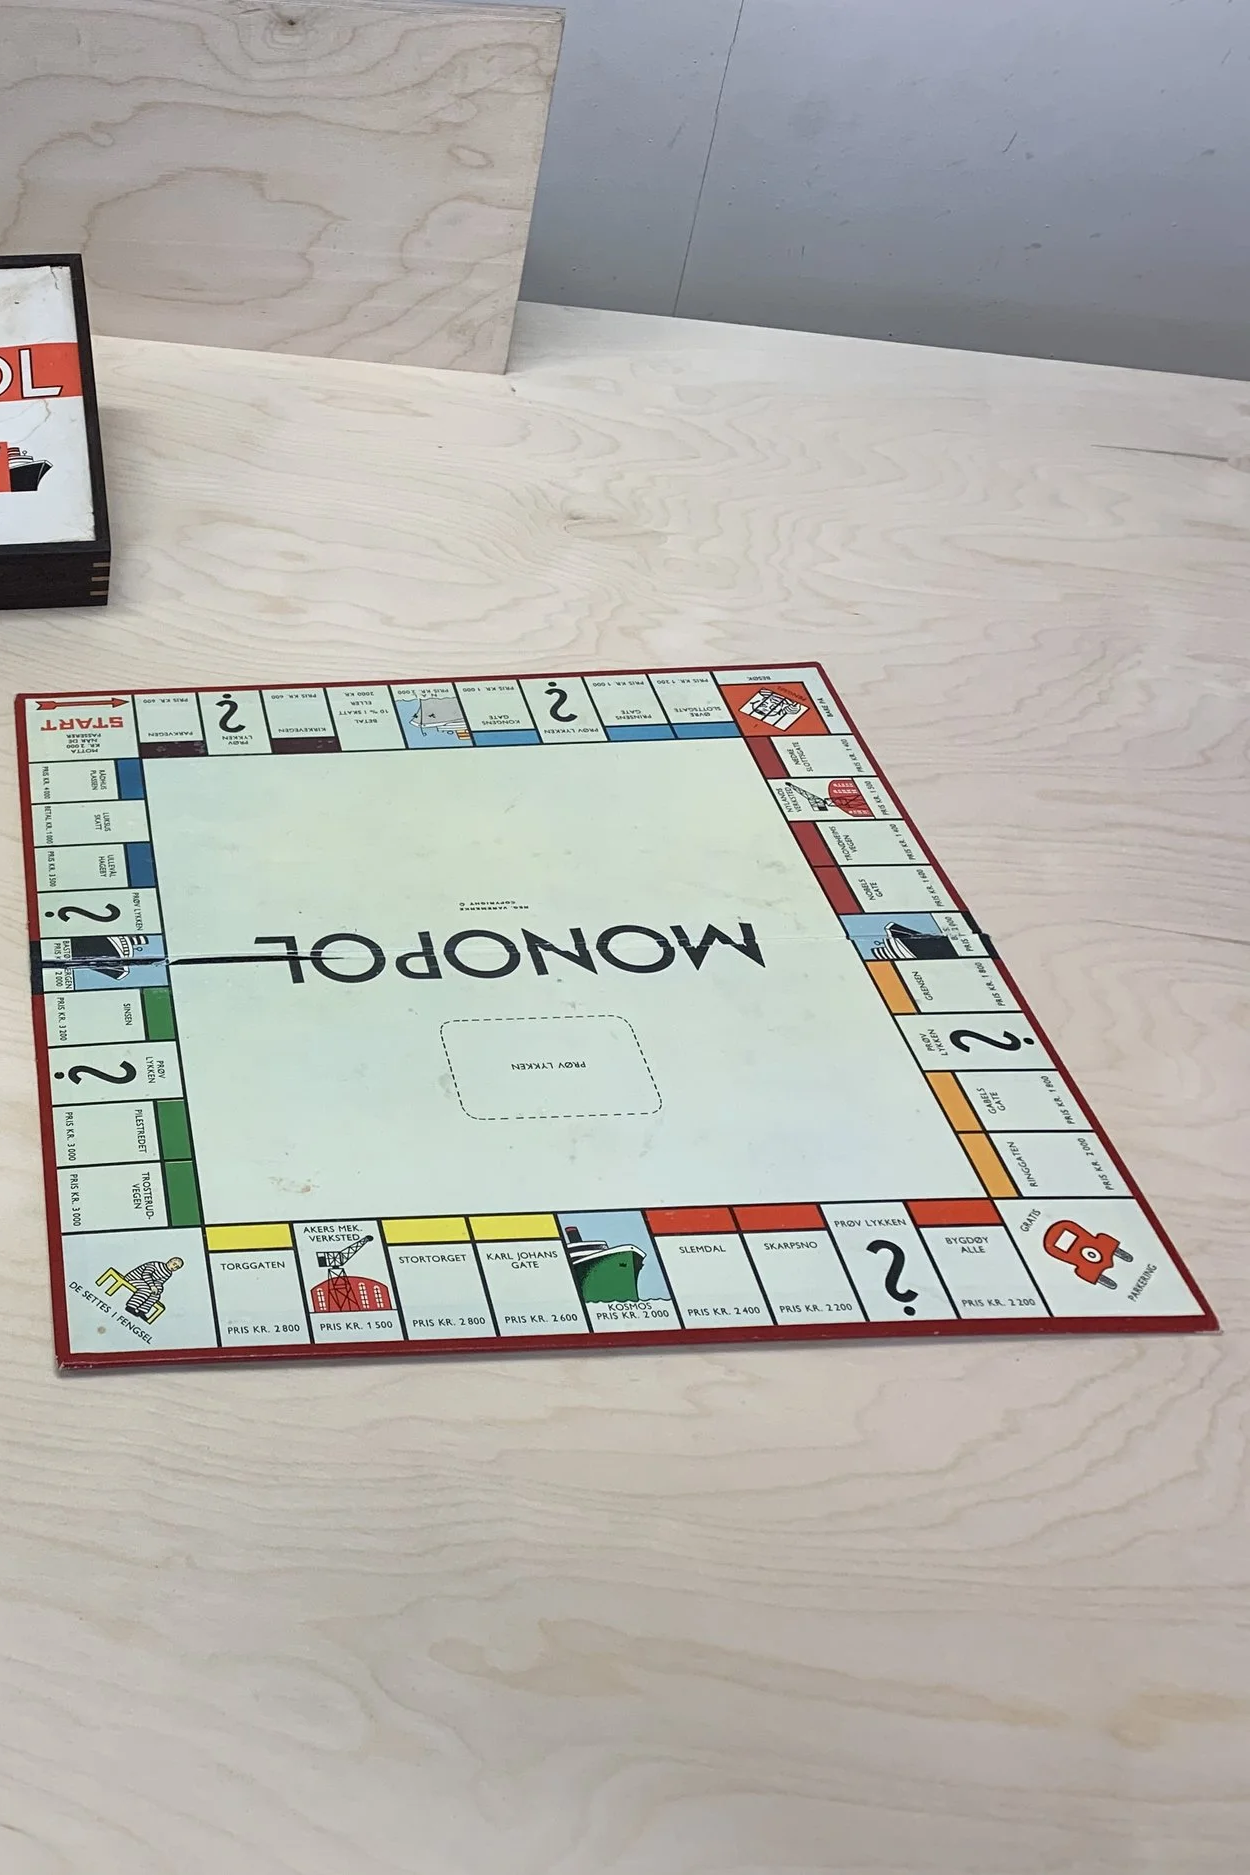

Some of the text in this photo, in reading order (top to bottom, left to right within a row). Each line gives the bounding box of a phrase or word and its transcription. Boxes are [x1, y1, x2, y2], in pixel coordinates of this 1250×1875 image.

[40, 716, 124, 731] START
[786, 748, 801, 765] NEDRE
[792, 742, 814, 772] SLOTTSGATE
[853, 762, 864, 773] PRIS
[90, 770, 98, 790] PLASSEN
[98, 770, 107, 790] RÅDHUS
[775, 788, 794, 813] NYLANDS
[784, 785, 802, 813] VERKSTED
[44, 806, 52, 821] BETAL
[877, 804, 890, 816] PRIS
[94, 814, 102, 830] SKATT
[102, 812, 112, 832] LUKSUS
[828, 826, 853, 861] TRONDHEIMS
[842, 834, 858, 853] VEGEN
[904, 848, 916, 860] PRIS
[98, 856, 107, 878] HAGEBY
[107, 854, 117, 878] ULLEVÅL
[858, 878, 876, 900] NOBELS
[869, 882, 883, 898] GATE
[931, 895, 944, 907] PRIS
[132, 892, 143, 931] PRØV LYKKEN
[254, 922, 766, 984] MONOPOL
[912, 971, 934, 1001] GRENSEN
[56, 997, 66, 1010] PRIS
[992, 992, 1006, 1006] PRIS
[123, 1003, 132, 1026] SINSEN
[919, 1033, 936, 1052] PRØV
[927, 1029, 948, 1056] LYKKEN
[145, 1056, 156, 1084] LYKKEN
[156, 1060, 166, 1079] PRØV
[511, 1061, 586, 1070] PRØV LYKKEN
[976, 1088, 997, 1114] GABELS
[989, 1092, 1006, 1111] GATE
[65, 1112, 74, 1127] PRIS
[1060, 1109, 1075, 1124] PRIS
[134, 1109, 147, 1153] PILESTREDET
[1006, 1142, 1038, 1187] RINGGATEN
[70, 1174, 80, 1205] PRIS KR.
[1098, 1174, 1114, 1190] PRIS
[132, 1183, 142, 1209] VEGEN
[142, 1172, 154, 1220] TROSTERUD-
[835, 1219, 906, 1228] PRØV LYKKEN
[1020, 1209, 1042, 1232] GRATIS
[303, 1225, 362, 1234] AKERS MEK.
[308, 1233, 360, 1243] VERKSTED
[764, 1241, 818, 1250] SKARPSNO
[945, 1237, 989, 1245] BYGDØY
[486, 1251, 558, 1260] KARL JOHANS
[679, 1244, 726, 1254] SLEMDAL
[961, 1246, 986, 1254] ALLE
[221, 1260, 285, 1271] TORGGATEN
[398, 1253, 468, 1265] STORTORGET
[511, 1260, 540, 1269] GATE
[1128, 1264, 1157, 1302] PARKERING
[608, 1302, 653, 1312] KOSMOS
[779, 1304, 801, 1313] PRIS
[804, 1303, 824, 1313] KR.
[962, 1299, 1006, 1307] PRIS KR.
[68, 1281, 84, 1294] DE
[82, 1287, 111, 1314] SETTES
[117, 1315, 154, 1345] FENGSEL
[505, 1315, 527, 1324] PRIS
[530, 1314, 548, 1323] KR.
[596, 1311, 618, 1320] PRIS
[622, 1311, 640, 1319] KR.
[687, 1308, 710, 1317] PRIS
[714, 1307, 731, 1316] KR.
[227, 1326, 250, 1335] PRIS
[253, 1325, 271, 1334] KR.
[320, 1322, 363, 1331] PRIS KR.
[412, 1318, 435, 1328] PRIS
[438, 1318, 456, 1327] KR.
